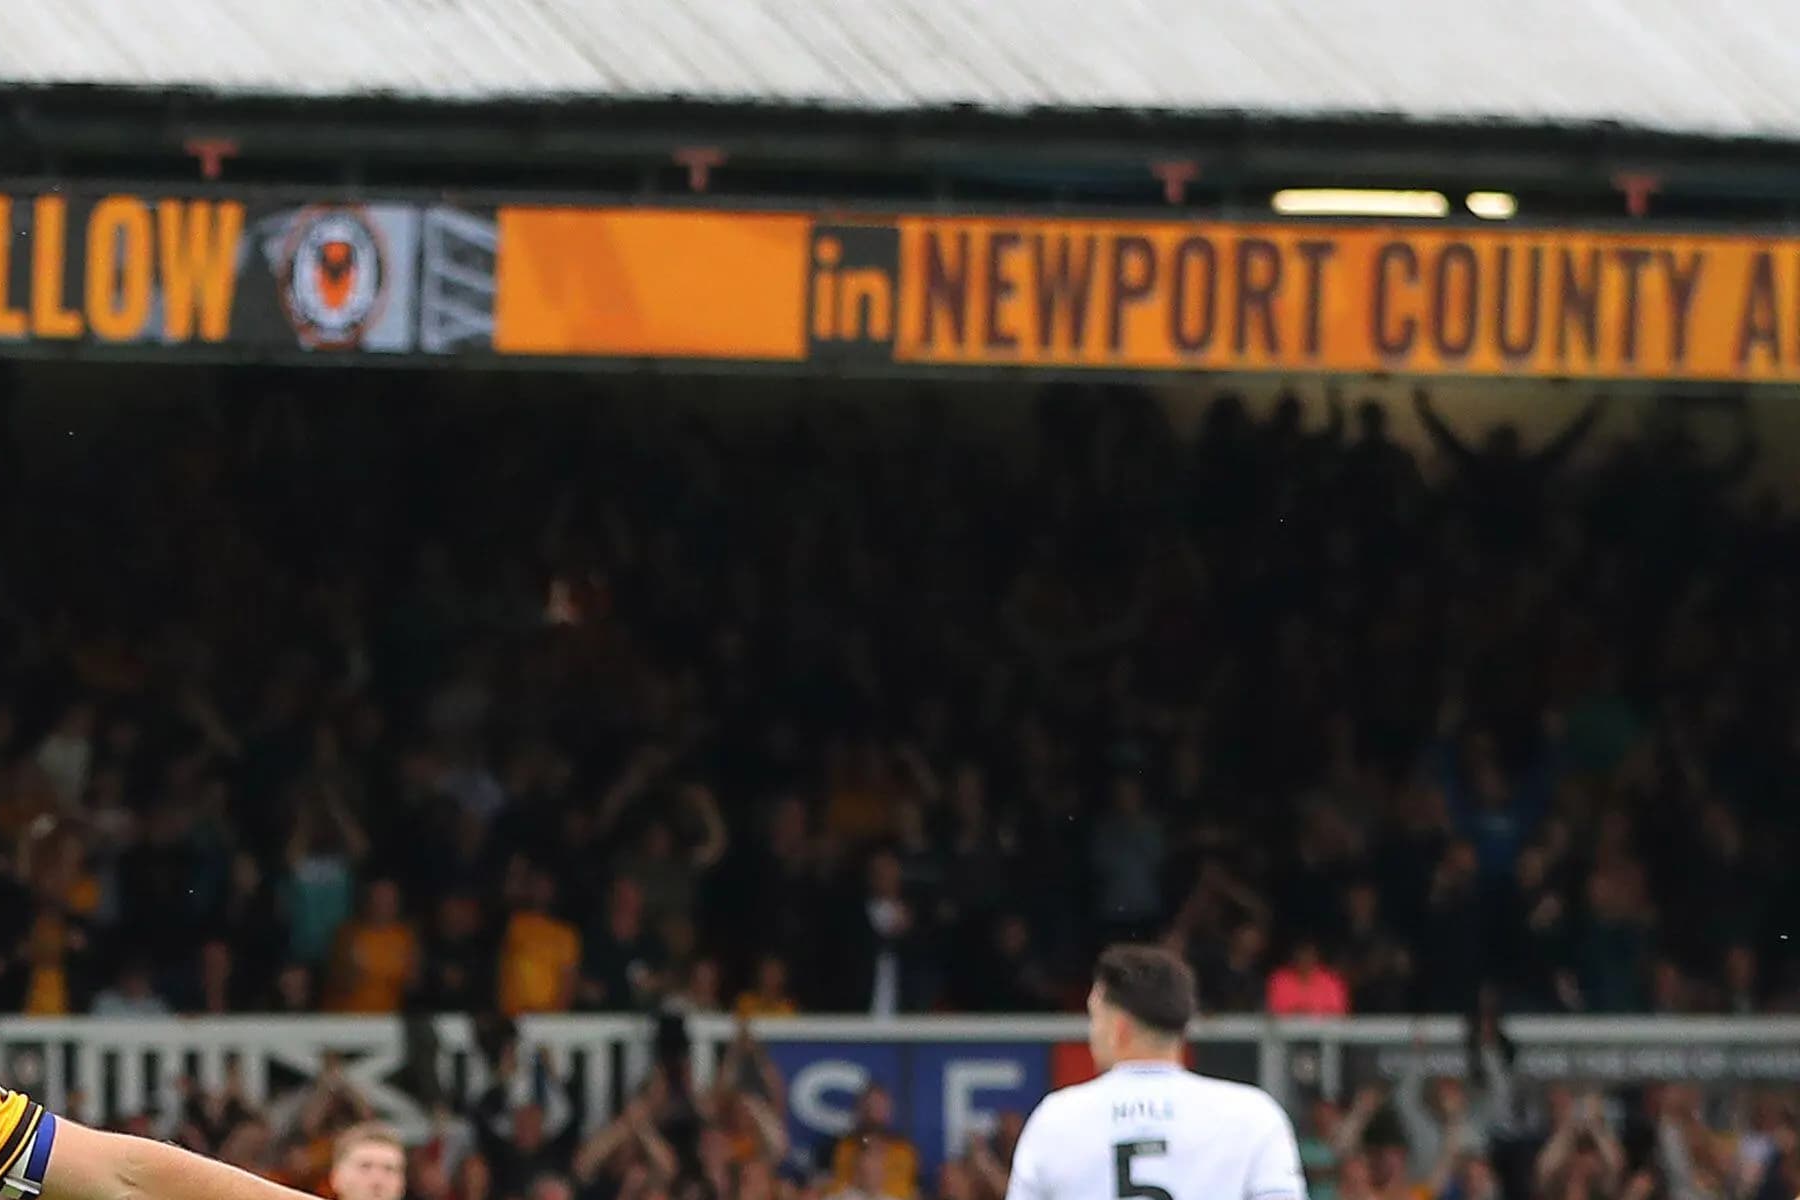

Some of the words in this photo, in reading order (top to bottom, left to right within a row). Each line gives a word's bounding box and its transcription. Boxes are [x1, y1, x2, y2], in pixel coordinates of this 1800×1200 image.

[813, 234, 892, 343] in
[919, 229, 1338, 358] NEWPORT
[1370, 240, 1706, 363] COUNTY
[1736, 250, 1800, 366] A
